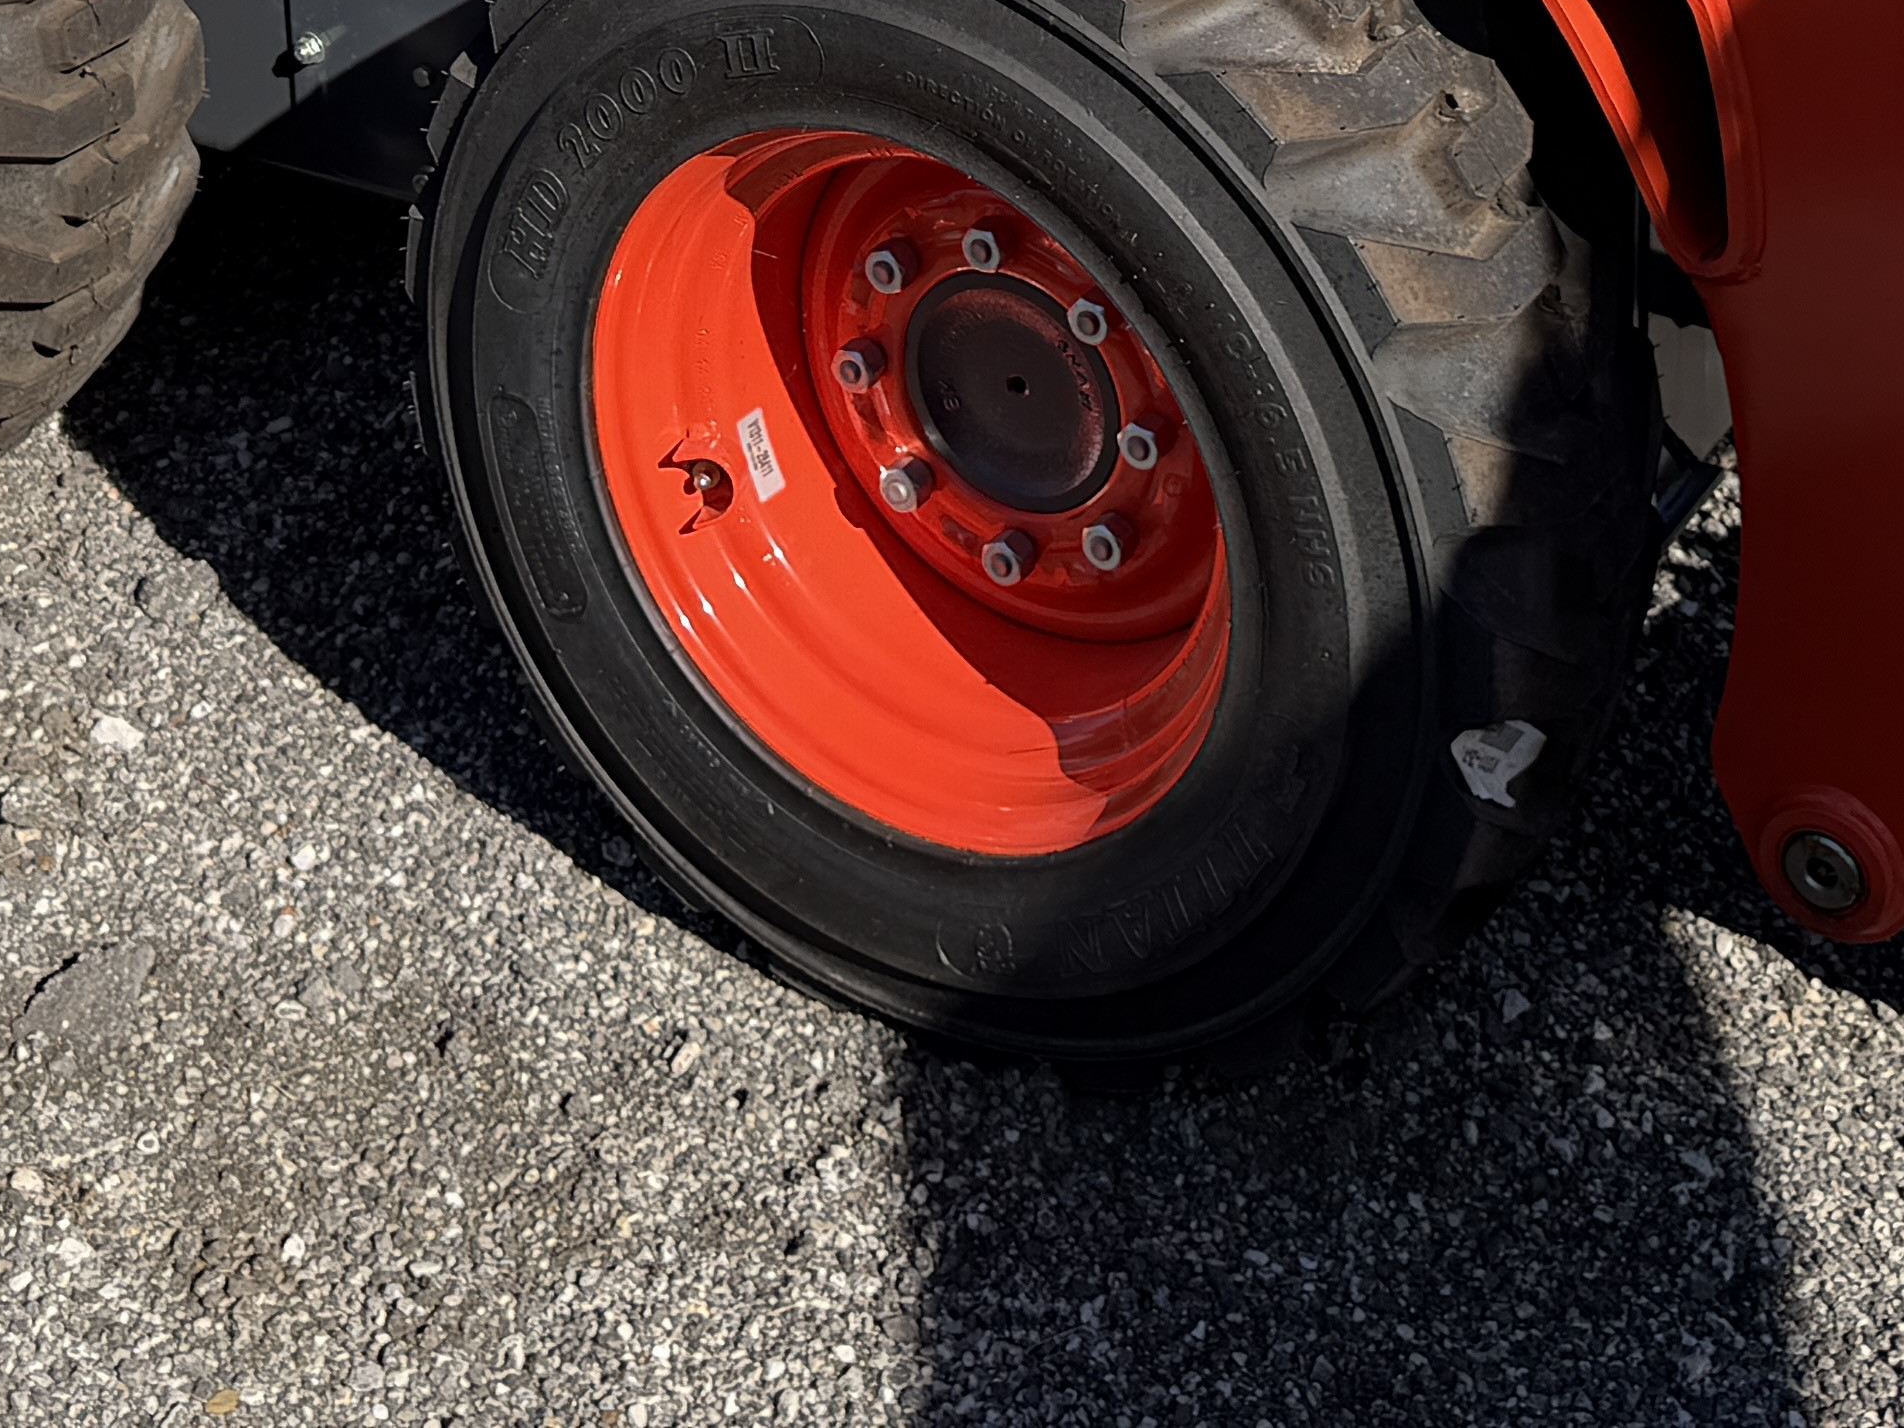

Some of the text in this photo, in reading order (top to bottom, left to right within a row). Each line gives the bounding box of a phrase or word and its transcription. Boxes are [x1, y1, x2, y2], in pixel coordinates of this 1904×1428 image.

[500, 164, 571, 282] HD
[555, 46, 698, 176] 2000
[1053, 817, 1275, 980] TITAN
